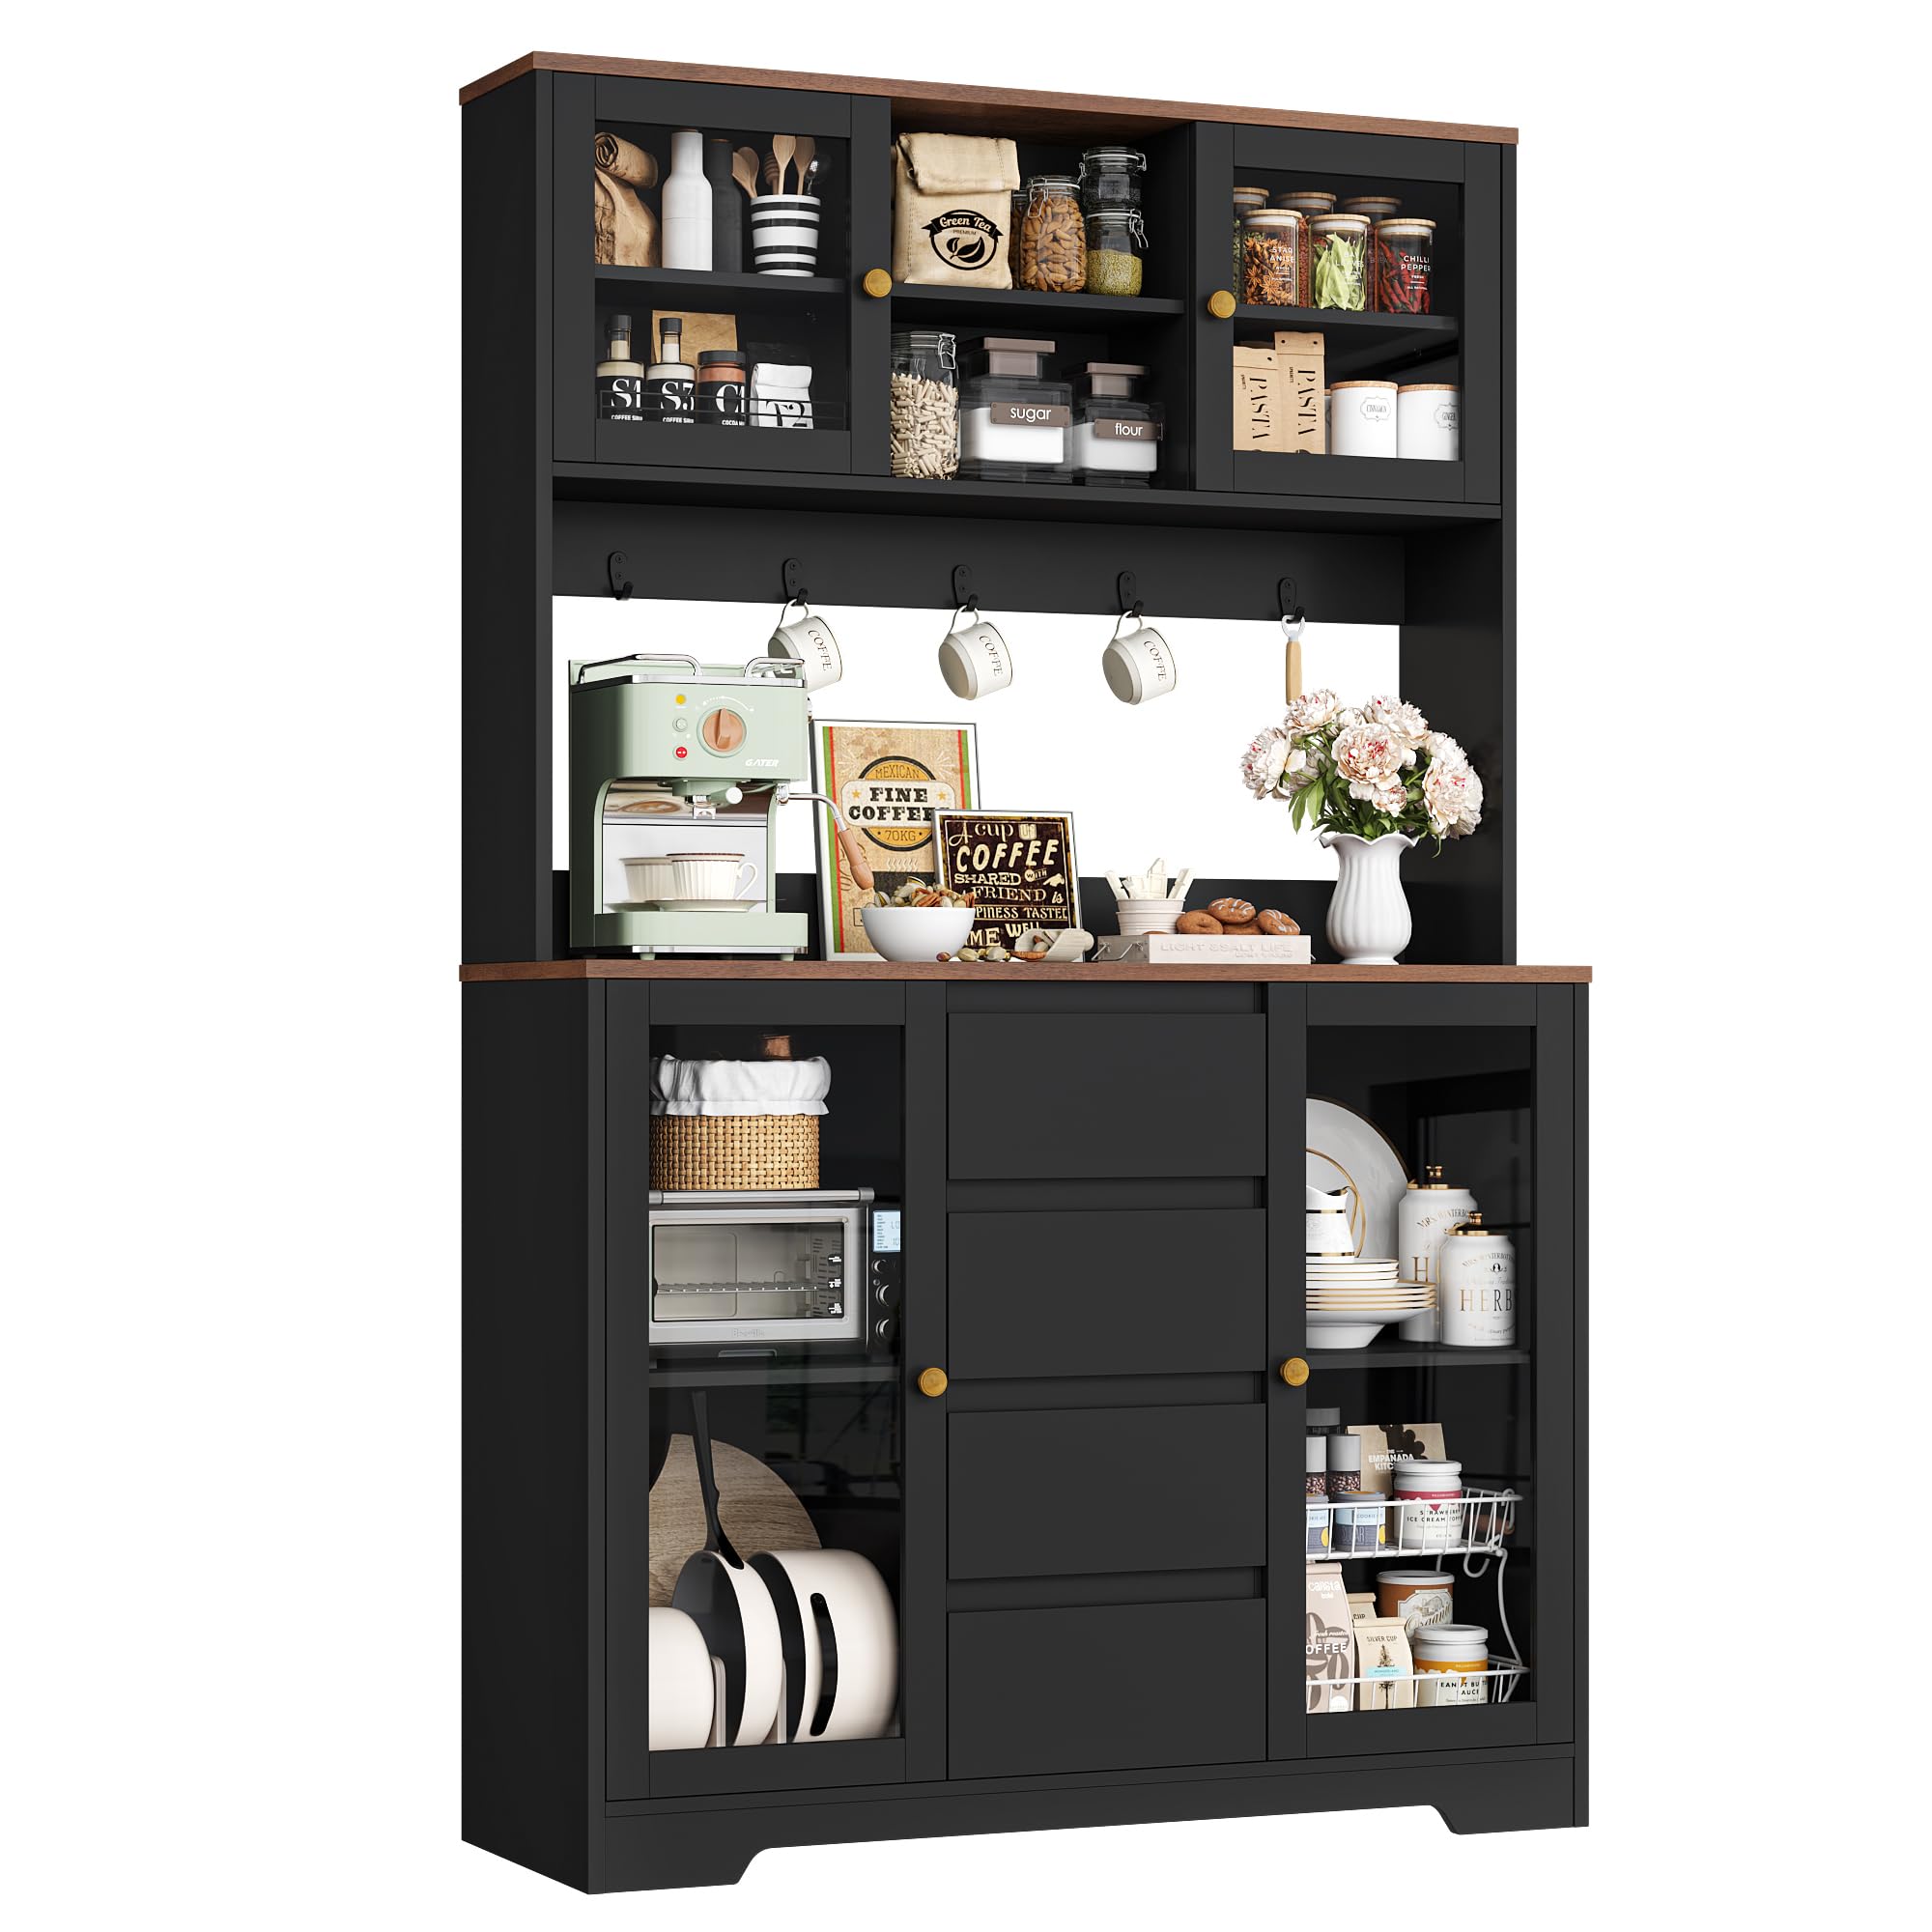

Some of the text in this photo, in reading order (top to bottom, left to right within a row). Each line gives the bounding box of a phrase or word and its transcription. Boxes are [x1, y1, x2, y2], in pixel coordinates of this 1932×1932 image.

[939, 216, 992, 232] Green Tea
[1249, 378, 1270, 439] PASTA
[1297, 370, 1317, 435] PASTA
[1009, 408, 1051, 422] sugar
[1115, 422, 1143, 436] flour
[808, 629, 833, 671] COFFE
[979, 635, 1003, 677] COFFE
[1143, 639, 1167, 682] COFFE
[745, 758, 780, 767] GATER
[875, 764, 920, 779] MEXICAN
[869, 787, 927, 803] FINE
[885, 830, 917, 841] 70KG
[975, 824, 1014, 842] cup
[956, 838, 1060, 872] COFFEE
[953, 872, 1022, 886] SHARED
[972, 886, 1064, 903] FRIEND is
[1368, 1453, 1414, 1463] EMPANADA
[1306, 1642, 1348, 1655] OFFEE
